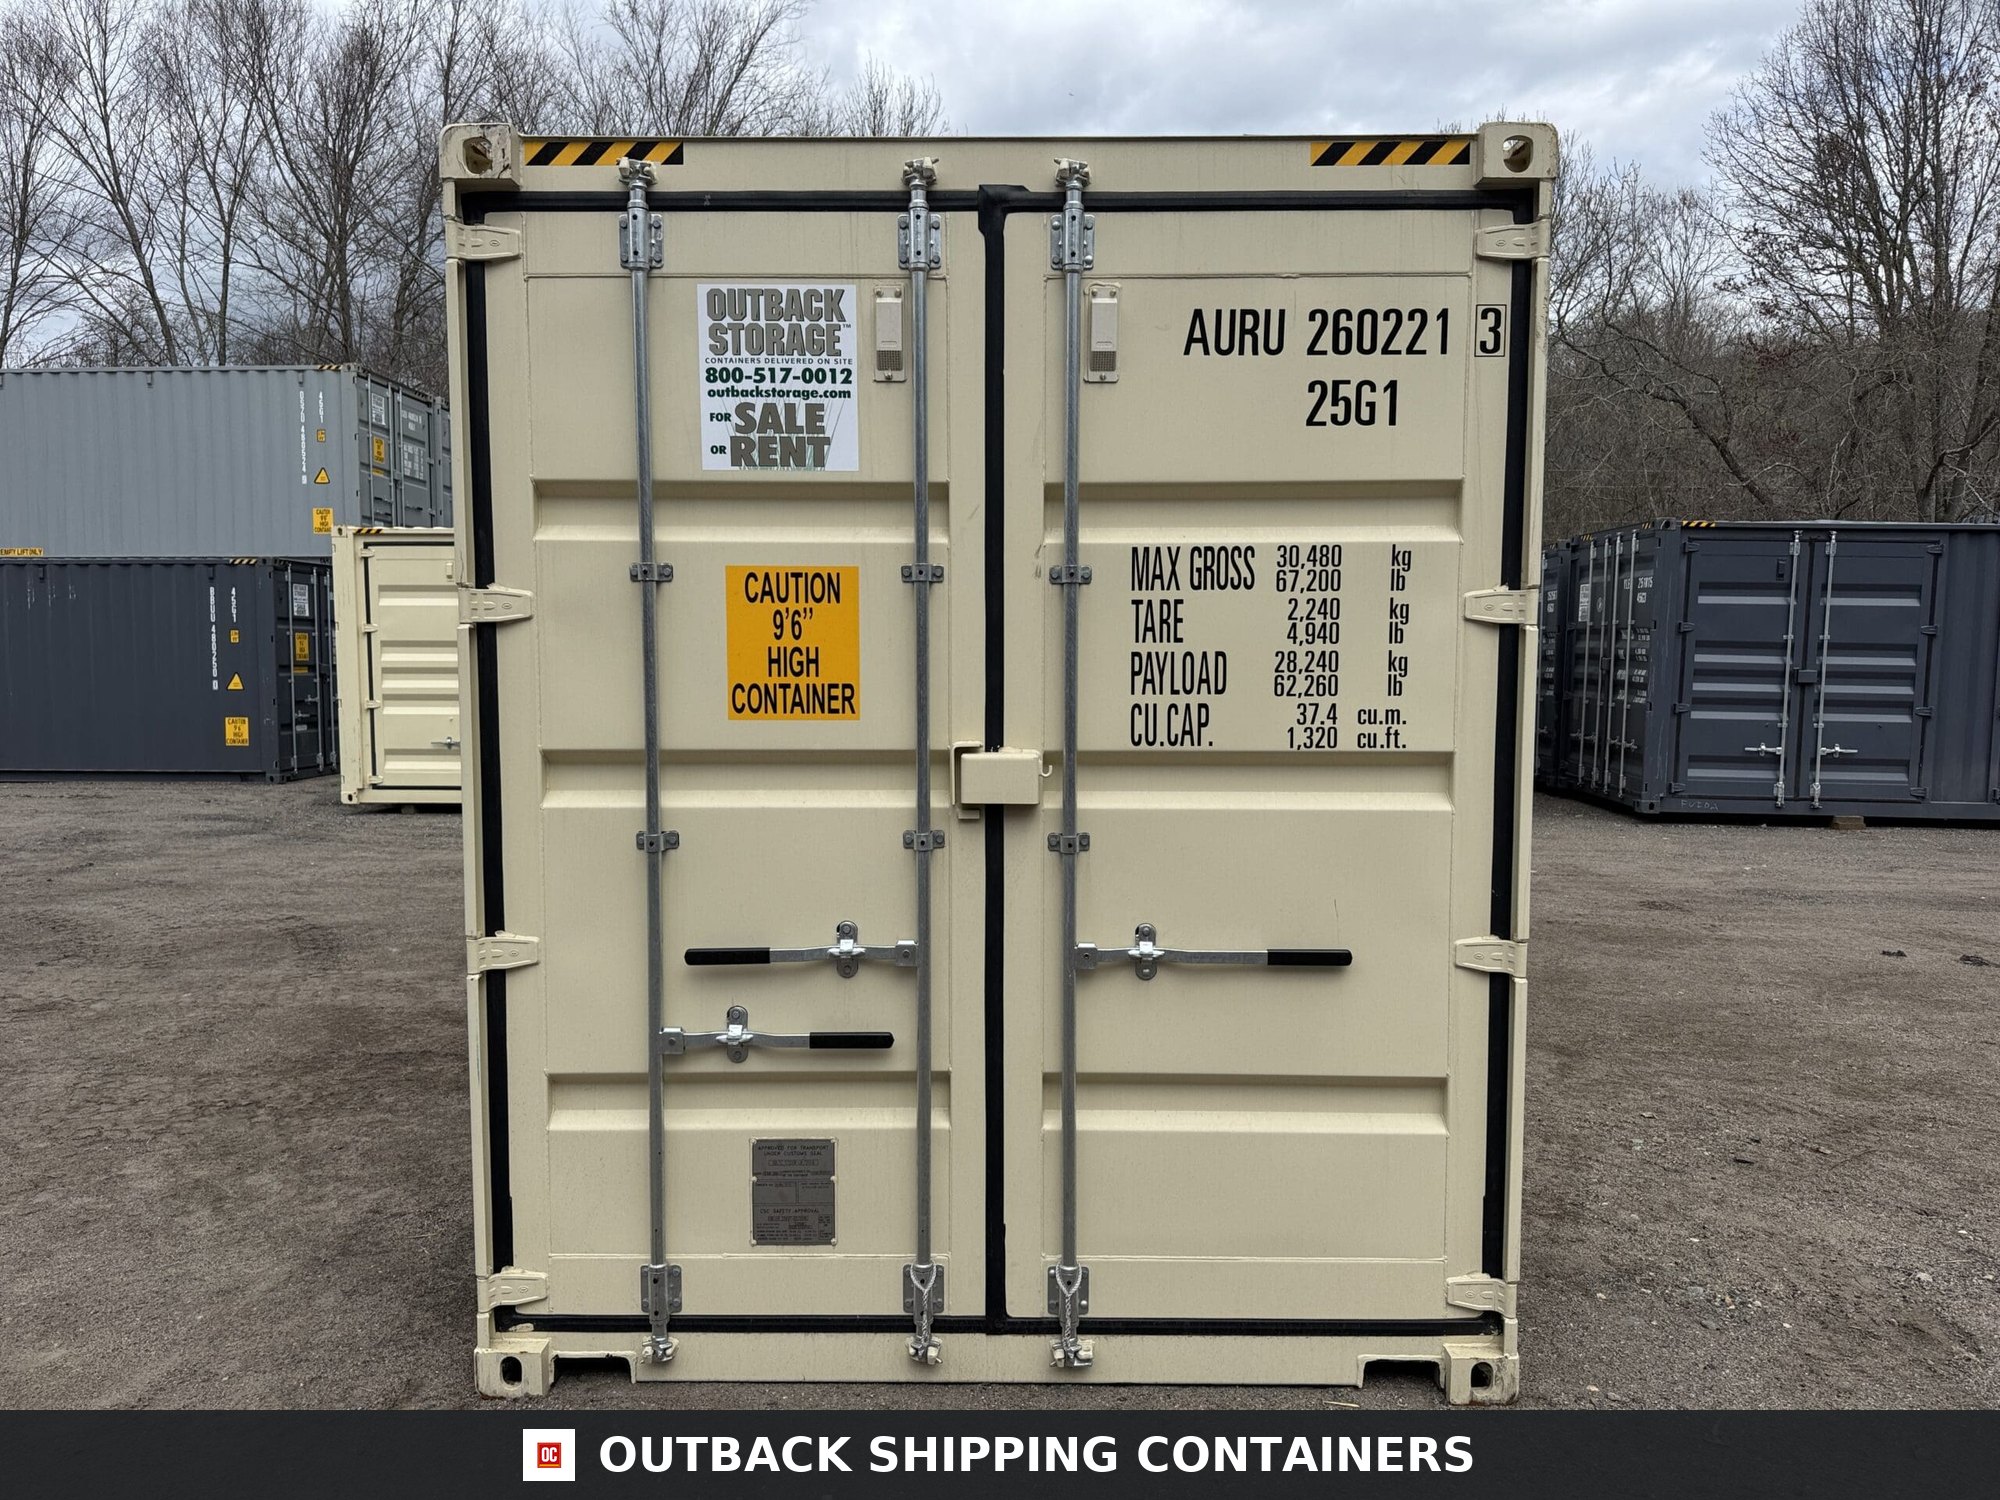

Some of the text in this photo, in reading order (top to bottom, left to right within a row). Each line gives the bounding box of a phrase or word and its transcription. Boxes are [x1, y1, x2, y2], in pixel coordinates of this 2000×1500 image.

[707, 288, 846, 322] OUTBACK
[708, 323, 841, 356] STORAGE
[1184, 307, 1501, 356] AURU 260221 3
[705, 367, 852, 384] 800-517-0012
[707, 386, 851, 400] outbackstorage.com
[1306, 380, 1398, 426] 25G1
[710, 402, 825, 434] FOR SALE
[710, 436, 831, 467] OR RENT
[1131, 546, 1255, 591] MAX GROSS
[1276, 544, 1412, 571] 30,480 kg
[745, 572, 841, 604] CAUTION
[1276, 568, 1406, 593] 67,200 lb
[1131, 599, 1184, 643] TARE
[1287, 597, 1410, 625] 2,240 kg
[1287, 622, 1404, 646] 4,940 lb
[768, 646, 819, 677] HIGH
[1130, 651, 1227, 695] PAYLOAD
[1274, 650, 1408, 677] 28,240 kg
[732, 683, 855, 714] CONTAINER
[1274, 674, 1402, 699] 62,260 lb
[1130, 703, 1213, 747] CU.CAP.
[1296, 703, 1407, 725] 37.4 cu.m.
[1287, 726, 1407, 750] 1,320 cu.ft.
